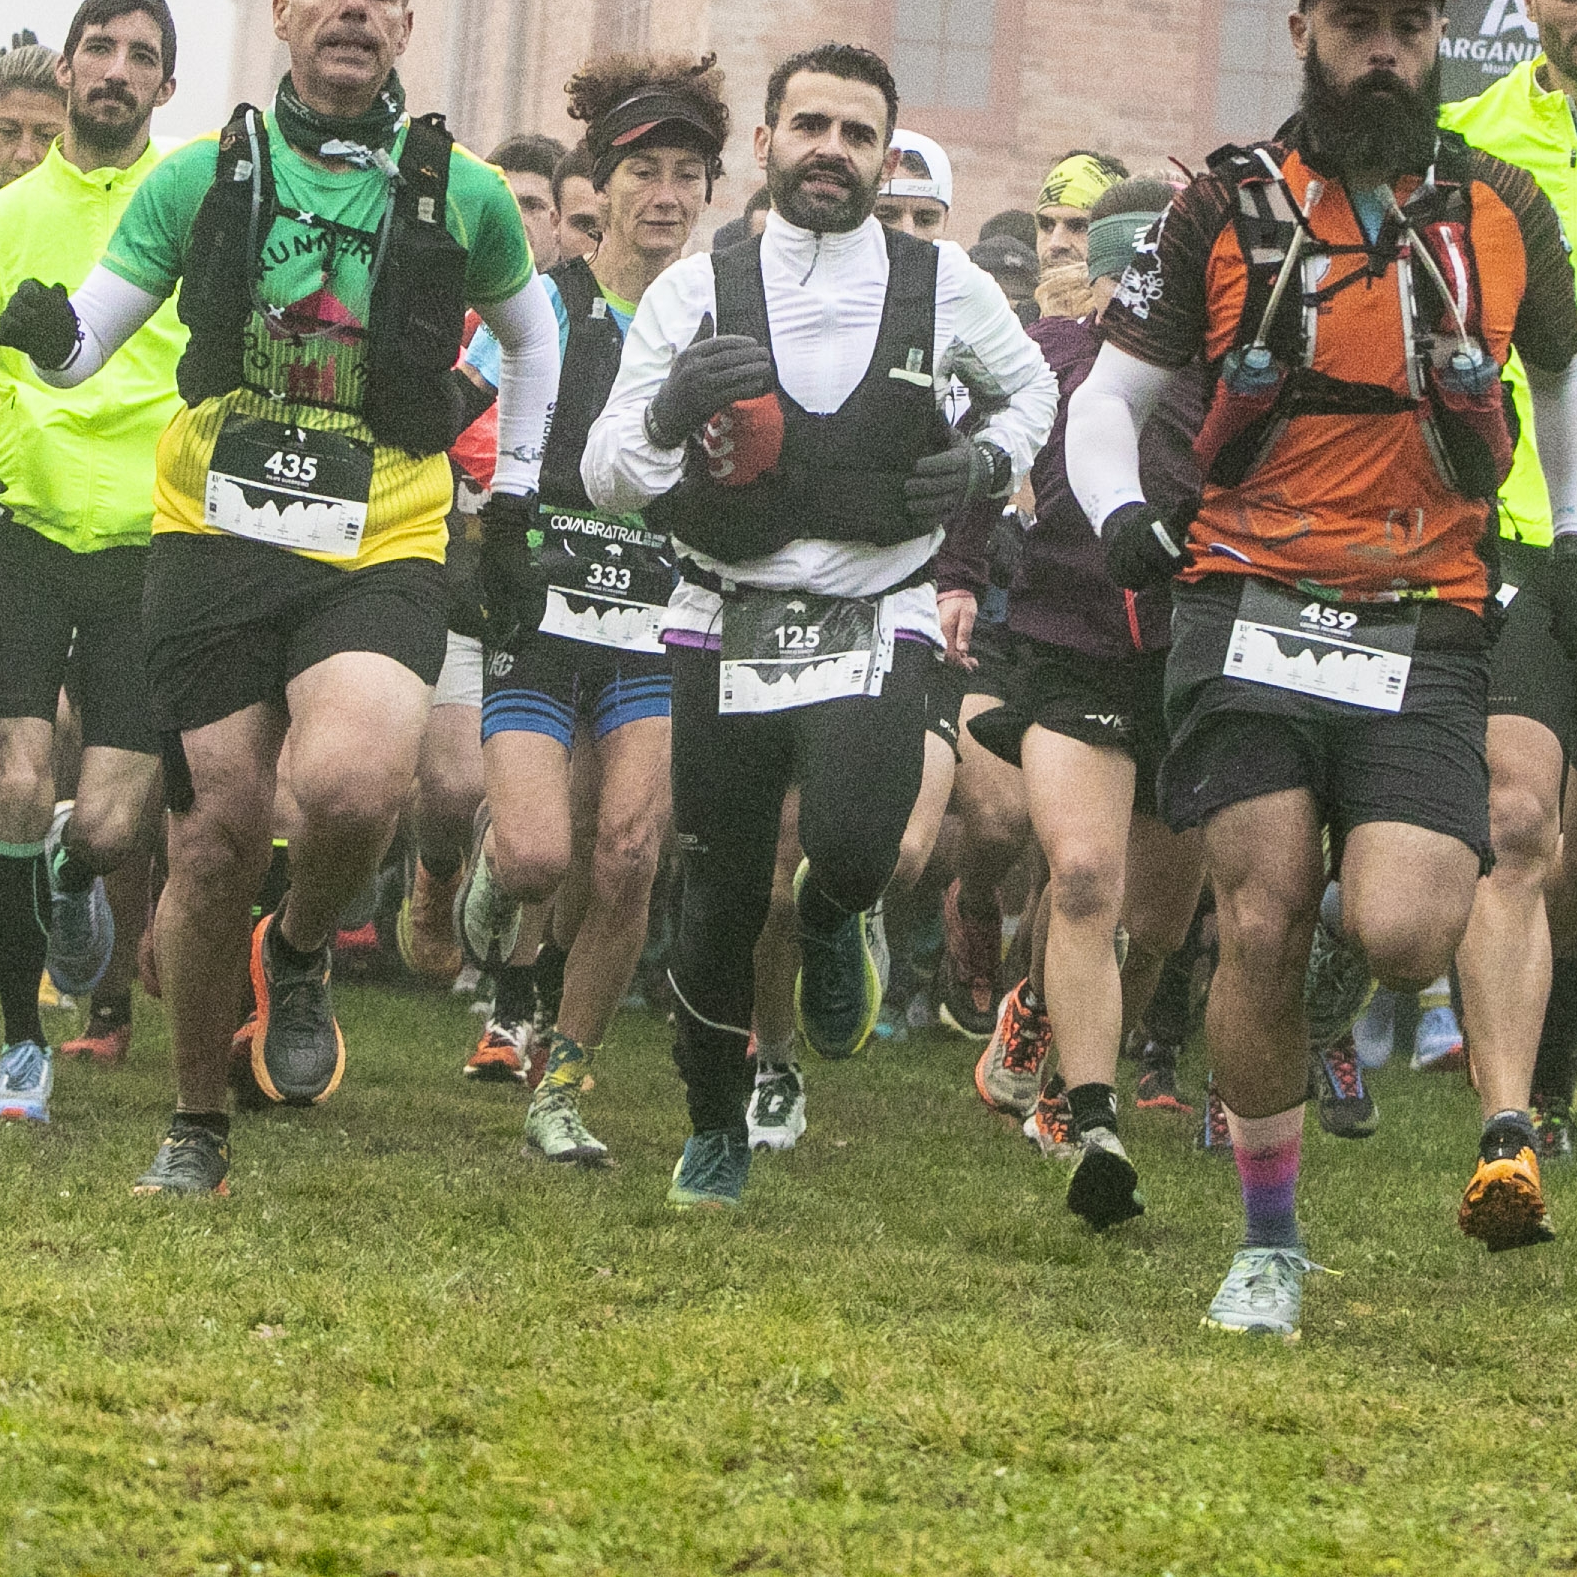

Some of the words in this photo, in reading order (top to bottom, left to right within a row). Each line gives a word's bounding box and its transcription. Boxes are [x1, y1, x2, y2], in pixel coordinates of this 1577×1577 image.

[264, 450, 318, 482] 435
[586, 562, 632, 590] 333
[1300, 601, 1359, 630] 459
[774, 624, 821, 649] 125
